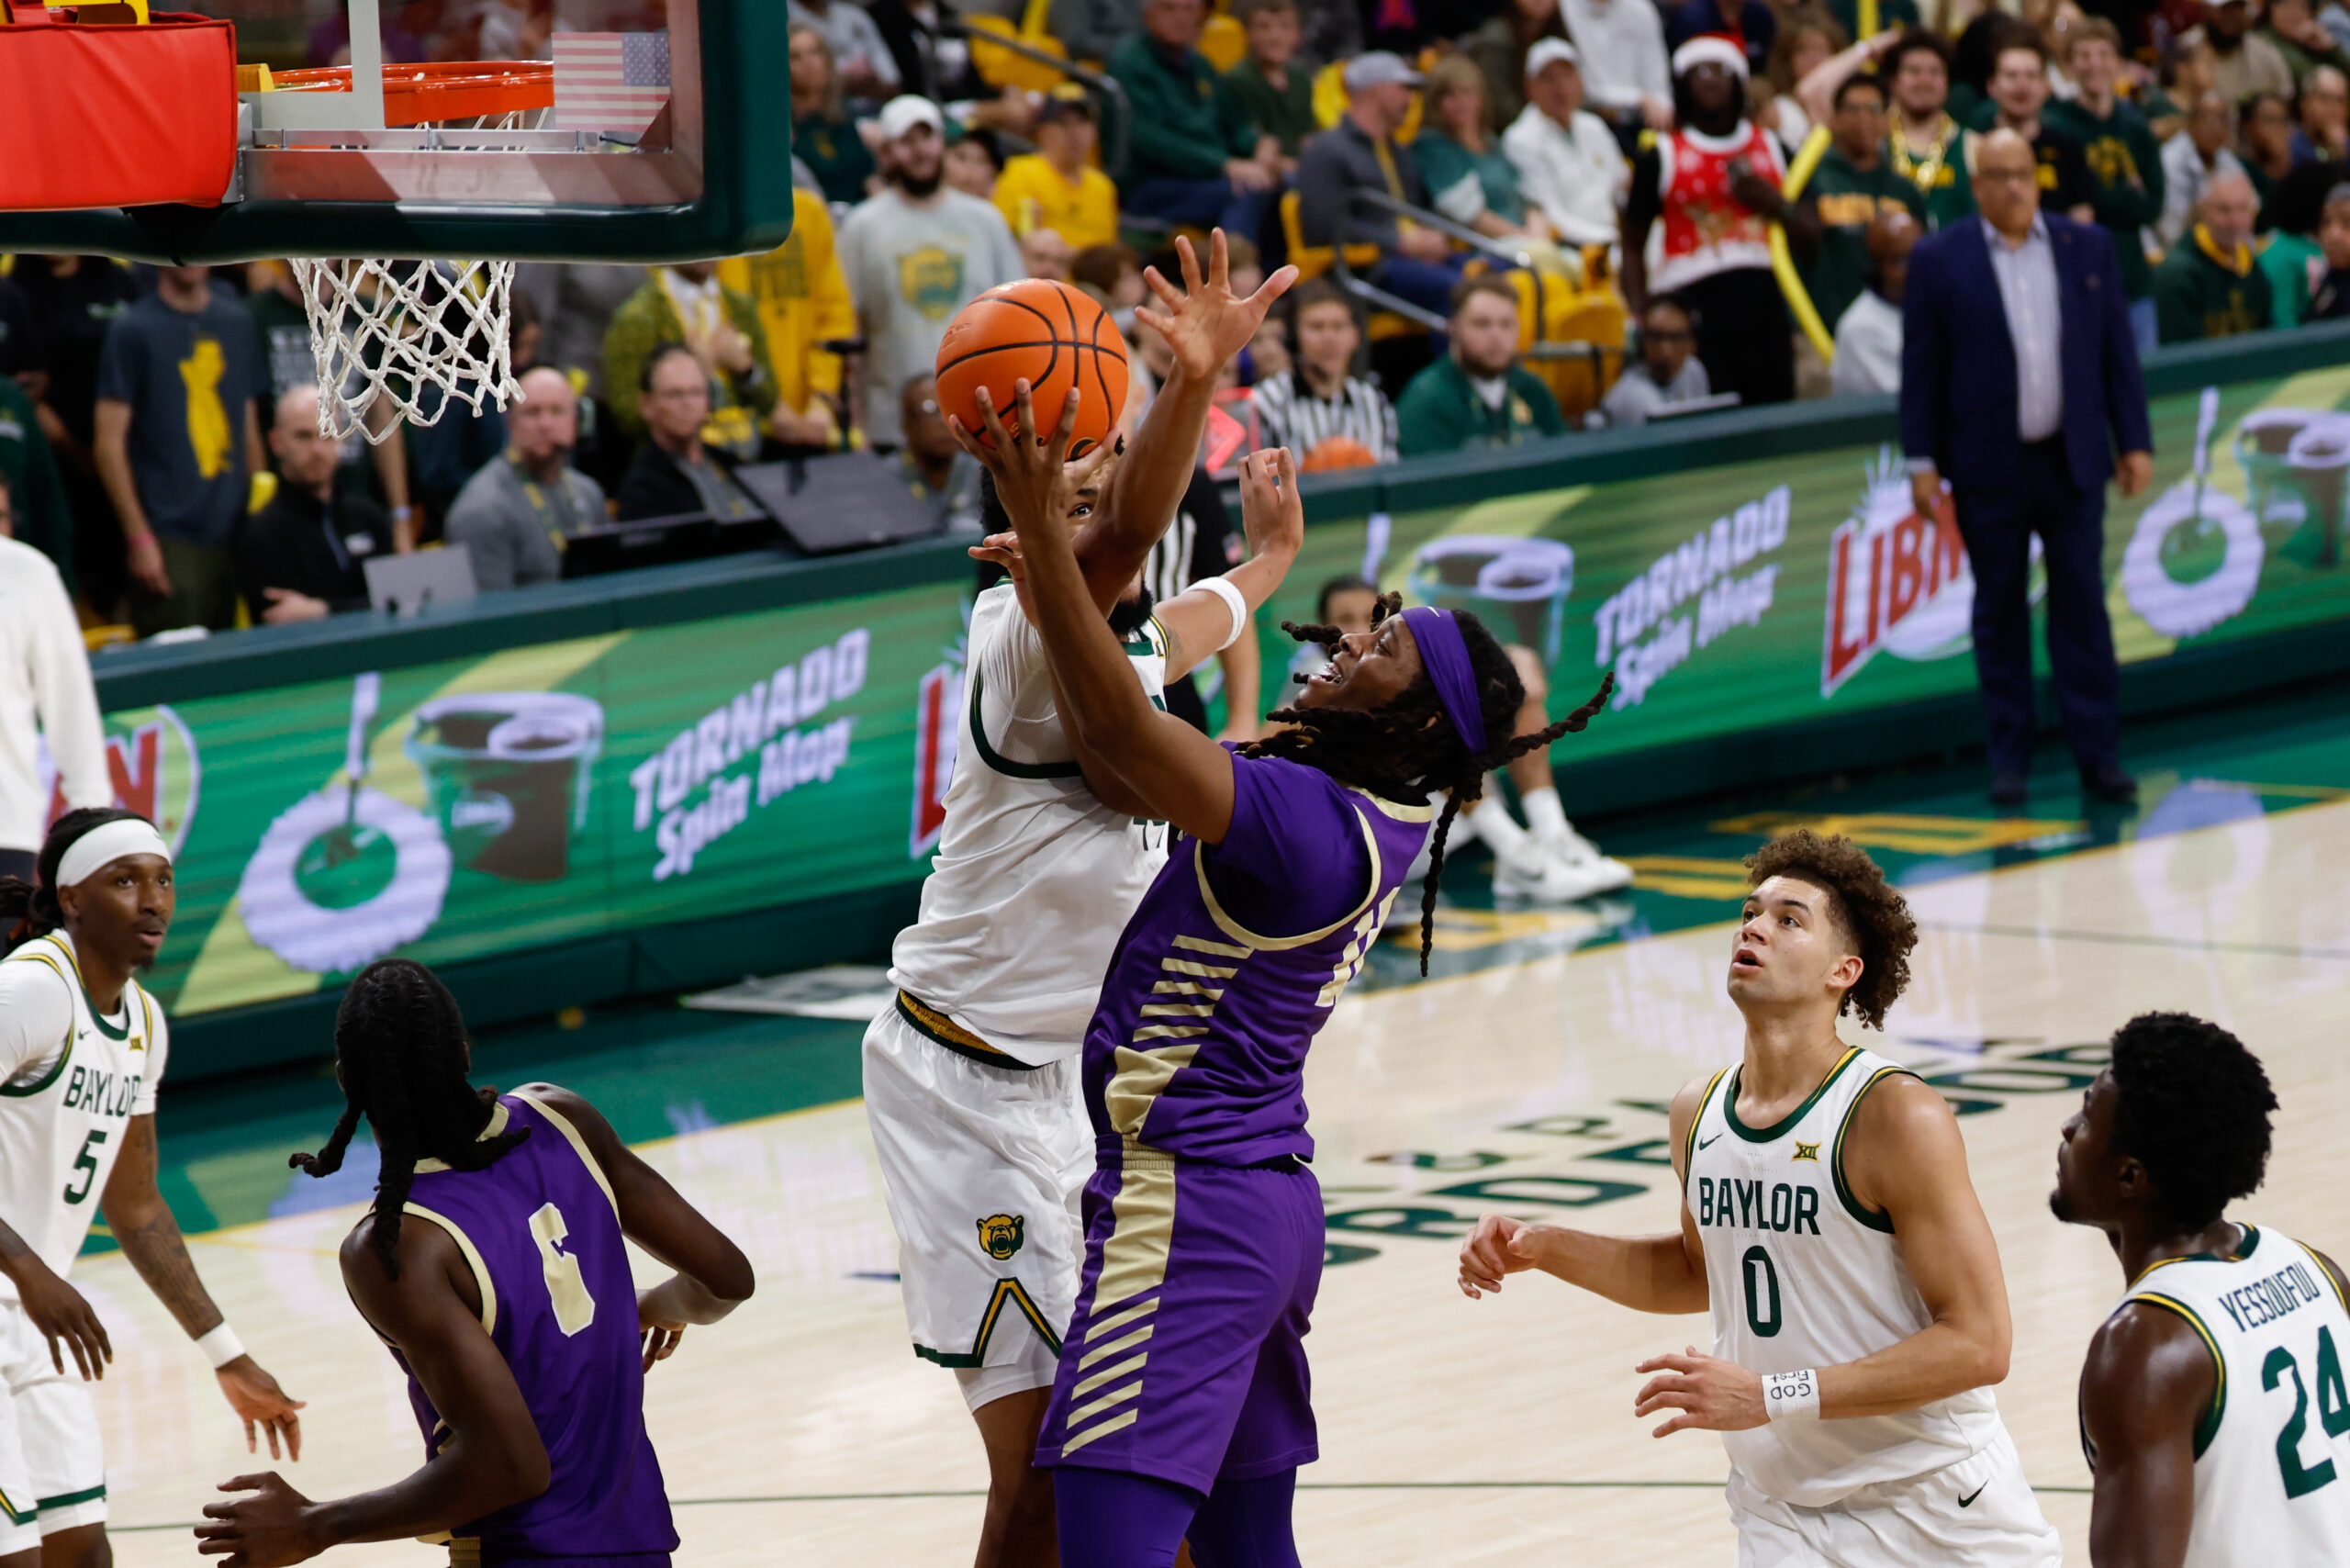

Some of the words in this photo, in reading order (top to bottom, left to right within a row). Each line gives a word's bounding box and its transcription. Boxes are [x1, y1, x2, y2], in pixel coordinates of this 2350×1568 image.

[1594, 484, 1792, 667] TORNADO
[1611, 614, 1692, 711] Spin
[1696, 564, 1782, 648] Mop
[630, 628, 869, 831] TORNADO
[653, 771, 751, 882] Spin
[756, 716, 854, 807] Mop
[63, 1129, 107, 1204] 5
[1699, 1176, 1821, 1236] BAYLOR
[528, 1202, 596, 1338] 6
[1742, 1245, 1782, 1338] 0
[2218, 1261, 2321, 1333] YESSOUFOU
[1770, 1383, 1811, 1400] GOD
[2261, 1325, 2350, 1500] 24
